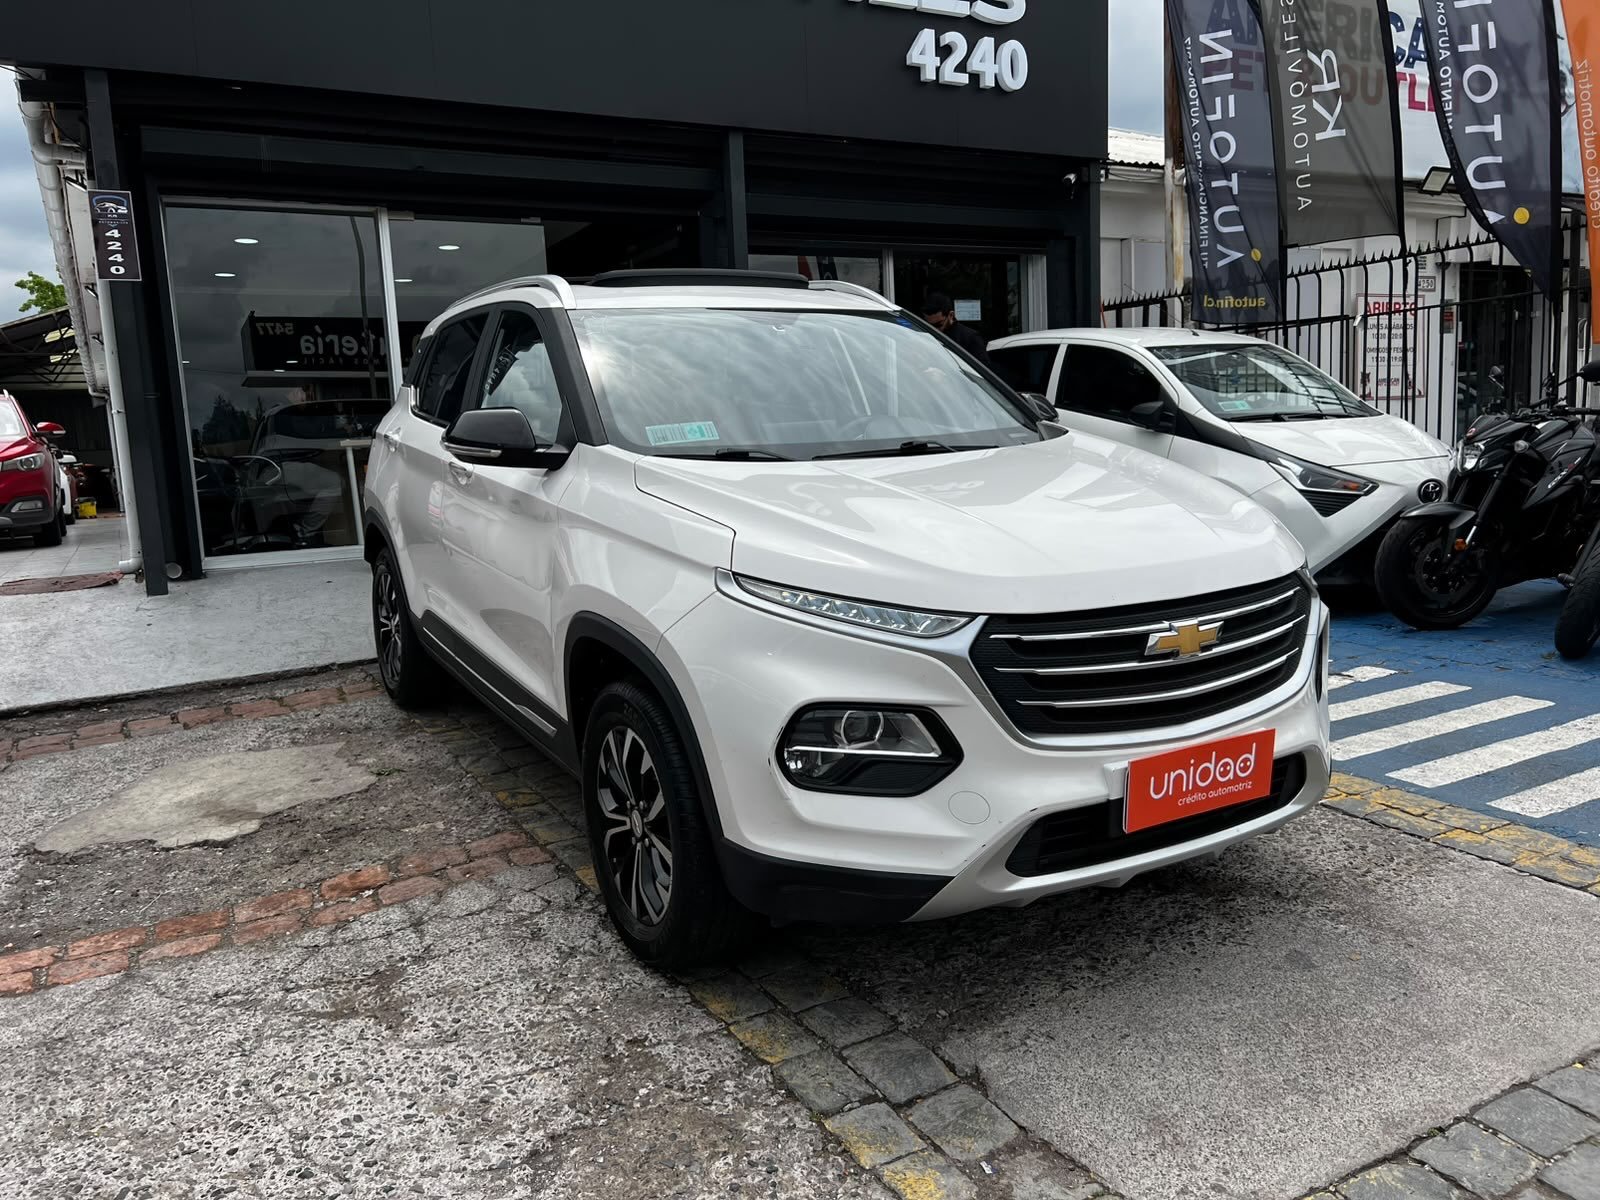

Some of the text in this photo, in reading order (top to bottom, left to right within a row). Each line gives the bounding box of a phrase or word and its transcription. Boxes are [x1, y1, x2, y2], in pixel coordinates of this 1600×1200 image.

[906, 28, 1029, 92] 4240
[105, 228, 126, 275] 4240
[1150, 742, 1257, 800] unidad
[1177, 780, 1253, 807] crédito automotriz
